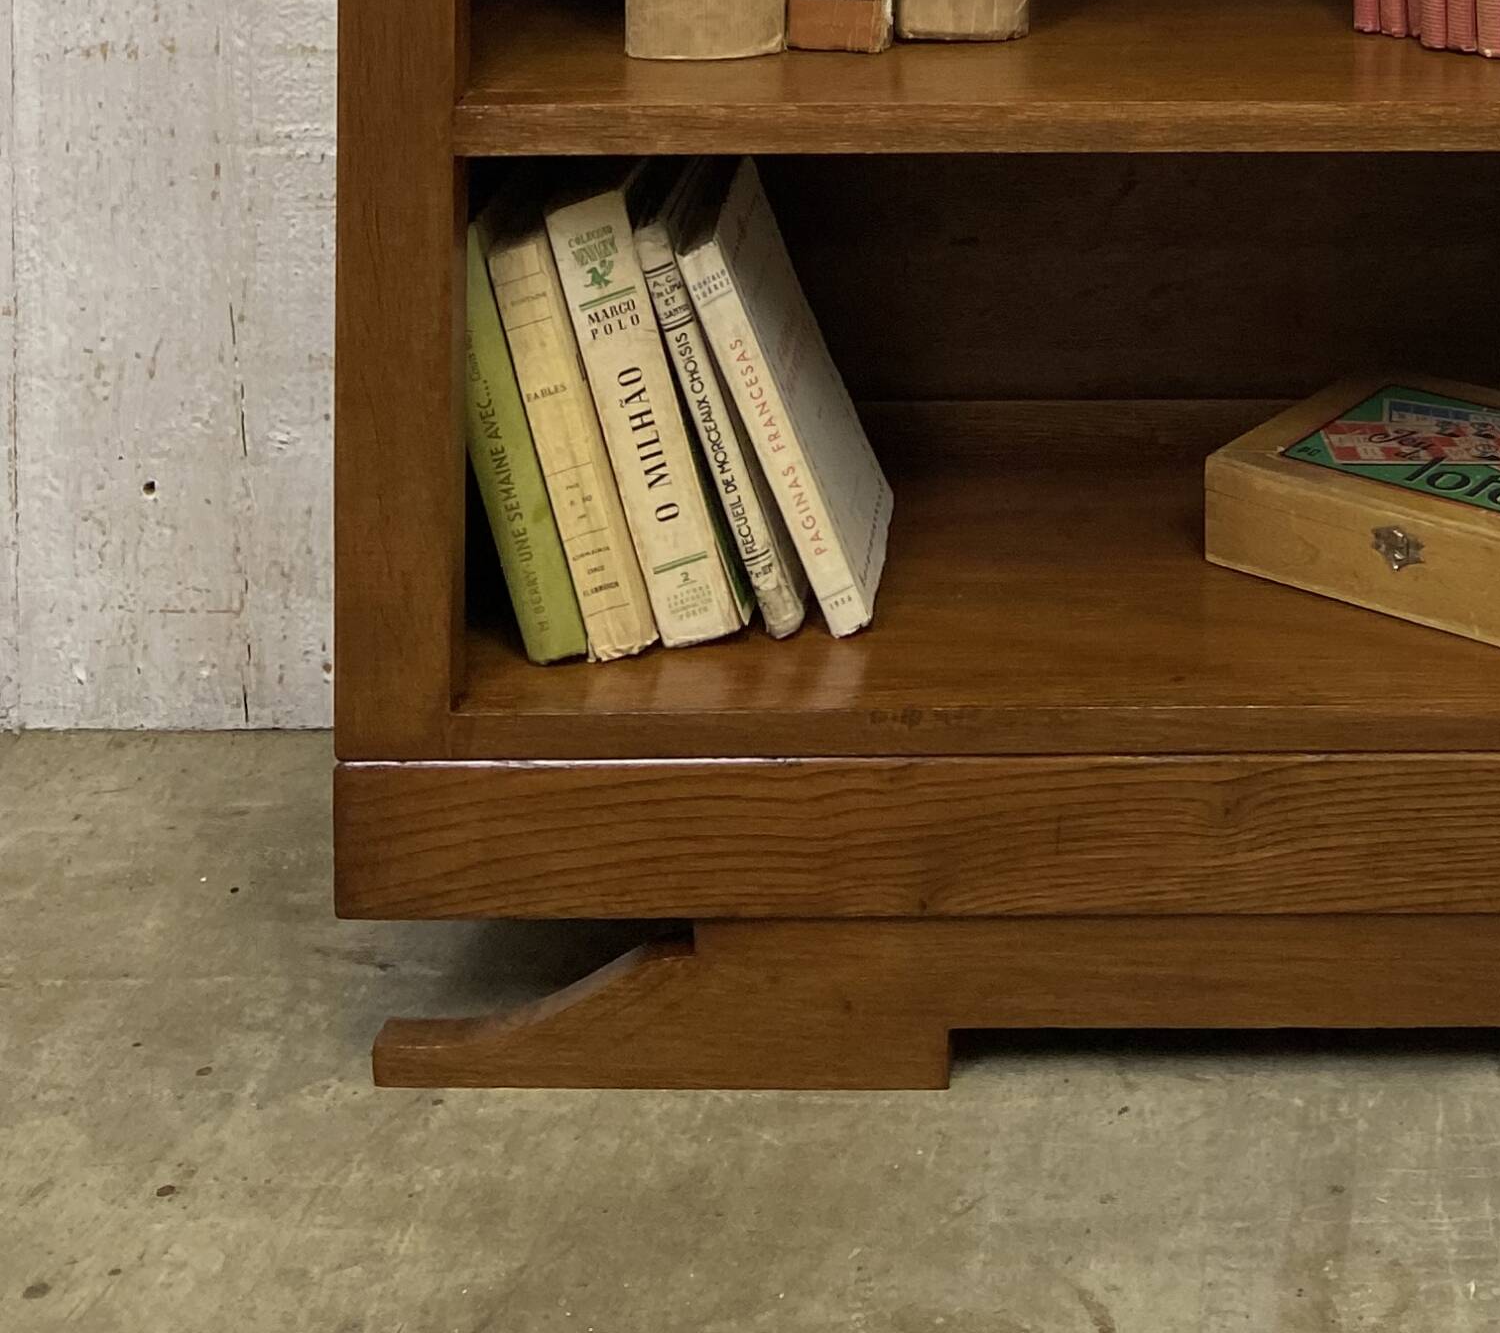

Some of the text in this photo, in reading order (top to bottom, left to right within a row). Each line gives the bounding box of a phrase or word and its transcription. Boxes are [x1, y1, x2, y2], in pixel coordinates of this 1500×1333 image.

[587, 298, 637, 326] MARCO
[590, 313, 641, 341] POLO
[526, 383, 568, 404] FABLES
[729, 338, 786, 454] FRANCESAS
[617, 365, 681, 523] O MILHÃO
[674, 331, 758, 555] RECUEIL DE MORCEAUX CHOISIS
[489, 445, 525, 525] SEMAINE
[511, 527, 535, 564] UNE
[679, 571, 690, 583] 2
